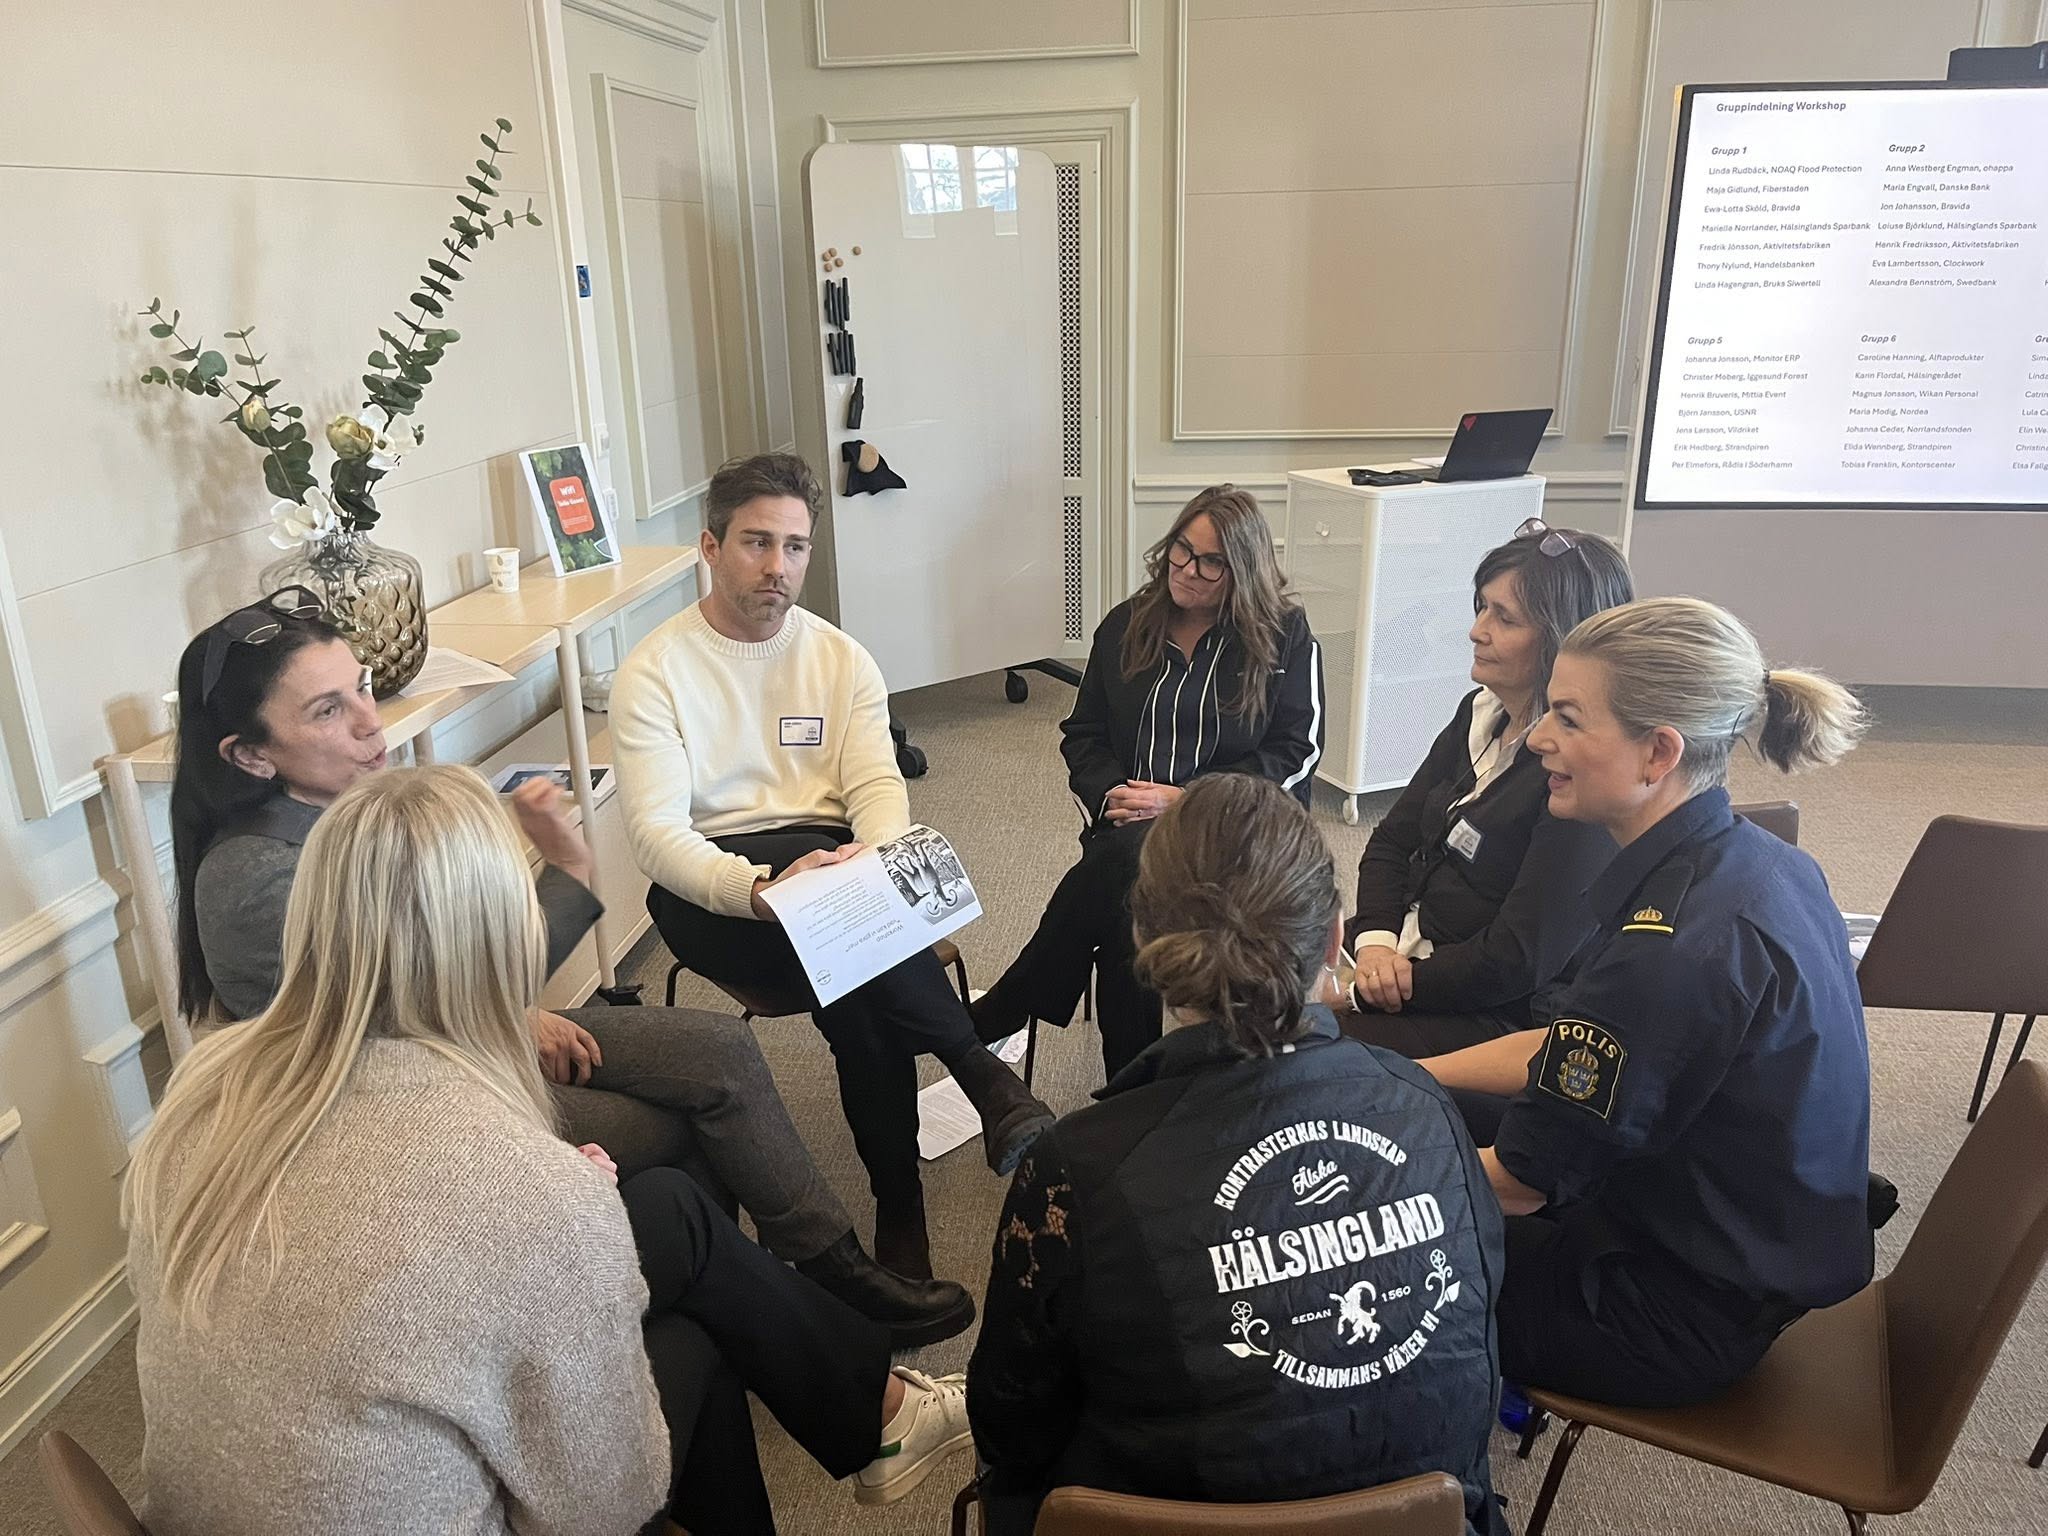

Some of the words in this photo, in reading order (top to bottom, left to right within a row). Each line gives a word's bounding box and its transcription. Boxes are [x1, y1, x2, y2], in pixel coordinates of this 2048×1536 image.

[1716, 102, 1794, 114] Gruppindelning
[1796, 101, 1846, 112] Workshop
[1711, 147, 1740, 156] Grupp
[1742, 146, 1747, 154] 1
[1888, 144, 1918, 154] Grupp
[1918, 144, 1926, 152] 2
[1771, 165, 1796, 174] NOAQ
[1797, 165, 1820, 173] Flood
[1821, 165, 1862, 173] Protection
[1908, 164, 1945, 174] Westberg
[1946, 164, 1981, 174] Engman,
[1706, 187, 1726, 195] Maja
[1727, 185, 1760, 194] Gidlund,
[1939, 183, 1969, 191] Danske
[1970, 183, 1990, 191] Bank
[1704, 205, 1744, 213] Ewa-Lotta
[1771, 204, 1800, 212] Bravida
[1941, 202, 1970, 210] Bravida
[1833, 222, 1871, 231] Sparbank
[2000, 222, 2037, 230] Sparbank
[1763, 242, 1830, 250] Aktivitetsfabriken
[1902, 241, 1950, 249] Fredriksson,
[1698, 262, 1720, 271] Thony
[1956, 278, 1997, 286] Swedbank
[1688, 337, 1716, 346] Grupp
[1716, 336, 1723, 344] 5
[1861, 334, 1889, 344] Grupp
[1784, 354, 1800, 362] ERP
[1892, 354, 1927, 362] Hanning,
[1715, 373, 1745, 382] Moberg,
[1747, 373, 1782, 382] Iggesund
[1783, 372, 1808, 380] Forest
[1852, 390, 1882, 399] Magnus
[1884, 390, 1917, 398] Jonsson,
[1678, 409, 1698, 417] Björn
[1734, 408, 1757, 416] USNR
[1872, 408, 1898, 416] Modig,
[1689, 444, 1723, 452] Hedberg,
[1907, 443, 1952, 451] Strandpiren
[1559, 1024, 1618, 1059] POLIS
[1213, 1119, 1329, 1212] KONTRASTERNAS
[1332, 1120, 1407, 1166] LANDSKAP
[1291, 1159, 1338, 1196] Älska
[1208, 1193, 1445, 1294] HÄLSINGLAND
[1291, 1309, 1332, 1325] SEDAN
[1381, 1285, 1412, 1302] 1560
[1272, 1349, 1382, 1389] TILLSAMMANS
[1383, 1329, 1428, 1375] VÄXER
[1420, 1310, 1440, 1333] VI
